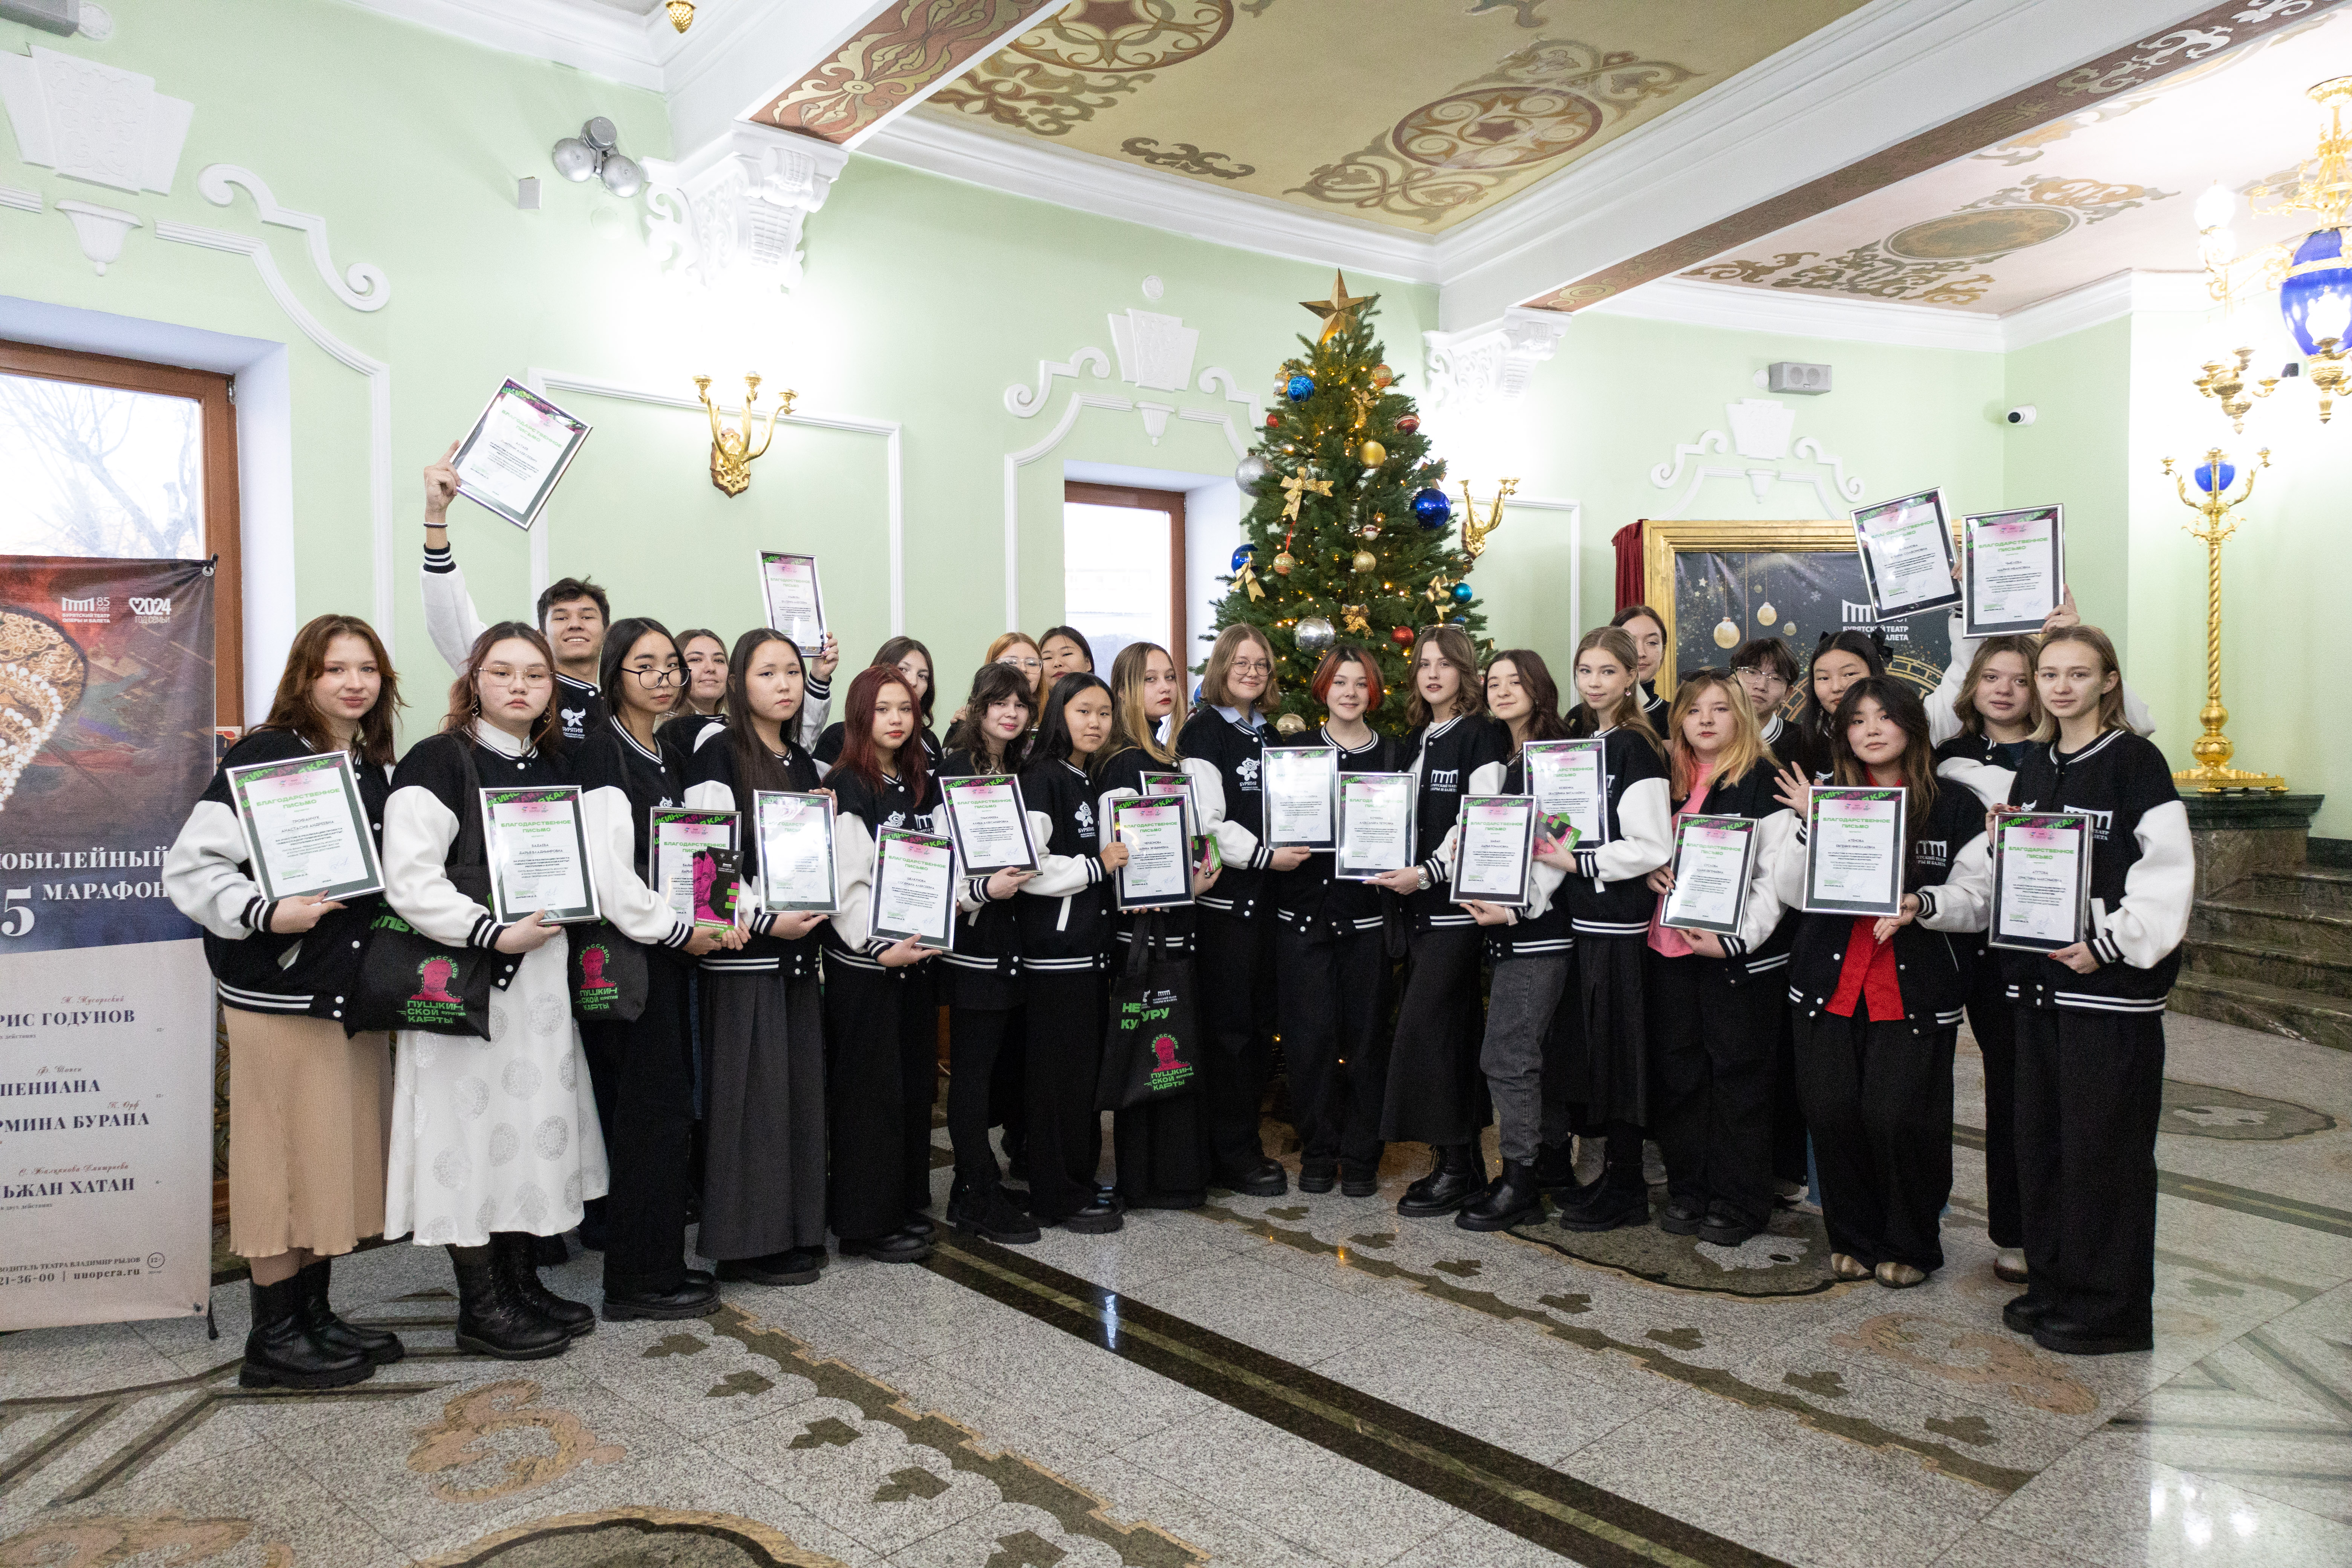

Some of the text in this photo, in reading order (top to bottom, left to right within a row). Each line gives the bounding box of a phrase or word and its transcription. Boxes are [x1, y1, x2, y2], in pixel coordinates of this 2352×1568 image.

[501, 409, 562, 449] БЛАГОДАРСТВЕННОЕ
[516, 425, 541, 442] ПИСЬМО
[1978, 537, 2048, 548] БЛАГОДАРСТВЕННОЕ
[96, 597, 110, 606] 85
[134, 597, 172, 615] 2024
[256, 788, 340, 806] БЛАГОДАРСТВЕННОЕ
[283, 799, 317, 808] ПИСЬМО
[1686, 843, 1741, 851] БЛАГОДАРСТВЕННОЕ
[888, 855, 946, 868] БЛАГОДАРСТВЕННОЕ
[42, 881, 169, 900] МАРАФОН
[418, 956, 458, 978] АМБАССАДОР
[580, 987, 617, 996] ПУШКИН
[407, 1000, 464, 1010] ПУШКИН
[1122, 1003, 1141, 1013] НЕ
[41, 1010, 135, 1027] ГОДУНОВ
[1152, 1034, 1178, 1053] АМБАССАДОР
[1151, 1066, 1192, 1079] ПУШКИН
[1152, 1076, 1174, 1084] СКОЙ
[1153, 1080, 1185, 1091] КАРТЫ
[0, 1079, 100, 1096] ПЕНИАНА
[73, 1112, 150, 1129] БУРАНА
[70, 1178, 135, 1194] ХАТАН
[70, 1259, 112, 1268] ВЛАДИМИР
